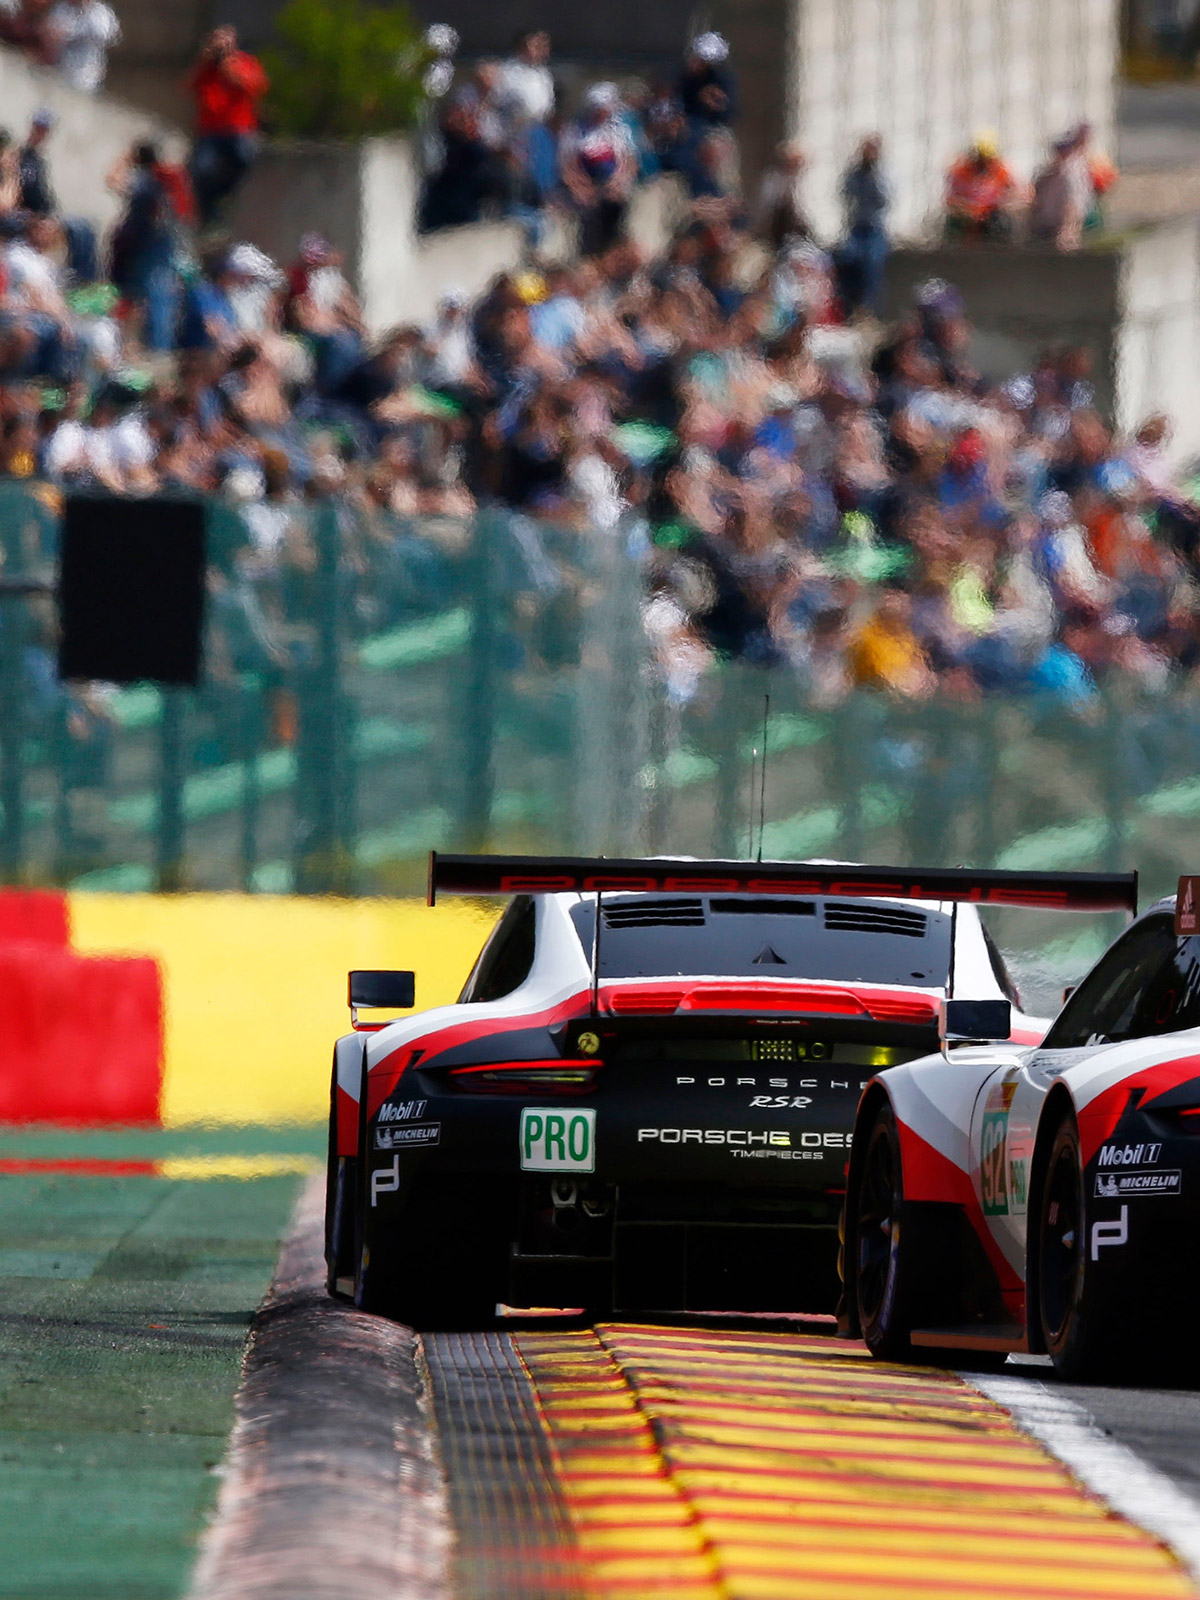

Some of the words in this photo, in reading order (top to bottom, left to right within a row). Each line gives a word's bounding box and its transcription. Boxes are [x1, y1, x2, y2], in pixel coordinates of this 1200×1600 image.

[500, 875, 1068, 907] PORSCHE
[378, 1101, 415, 1122] Mobil
[749, 1096, 813, 1109] RSR
[393, 1127, 439, 1140] MICHELIN
[525, 1114, 589, 1162] PRO
[637, 1128, 791, 1146] PORSCHE
[730, 1149, 823, 1160] TIMEPIECES
[983, 1120, 1006, 1208] 92
[1098, 1144, 1145, 1166] Mobil
[1119, 1175, 1179, 1188] MICHELIN
